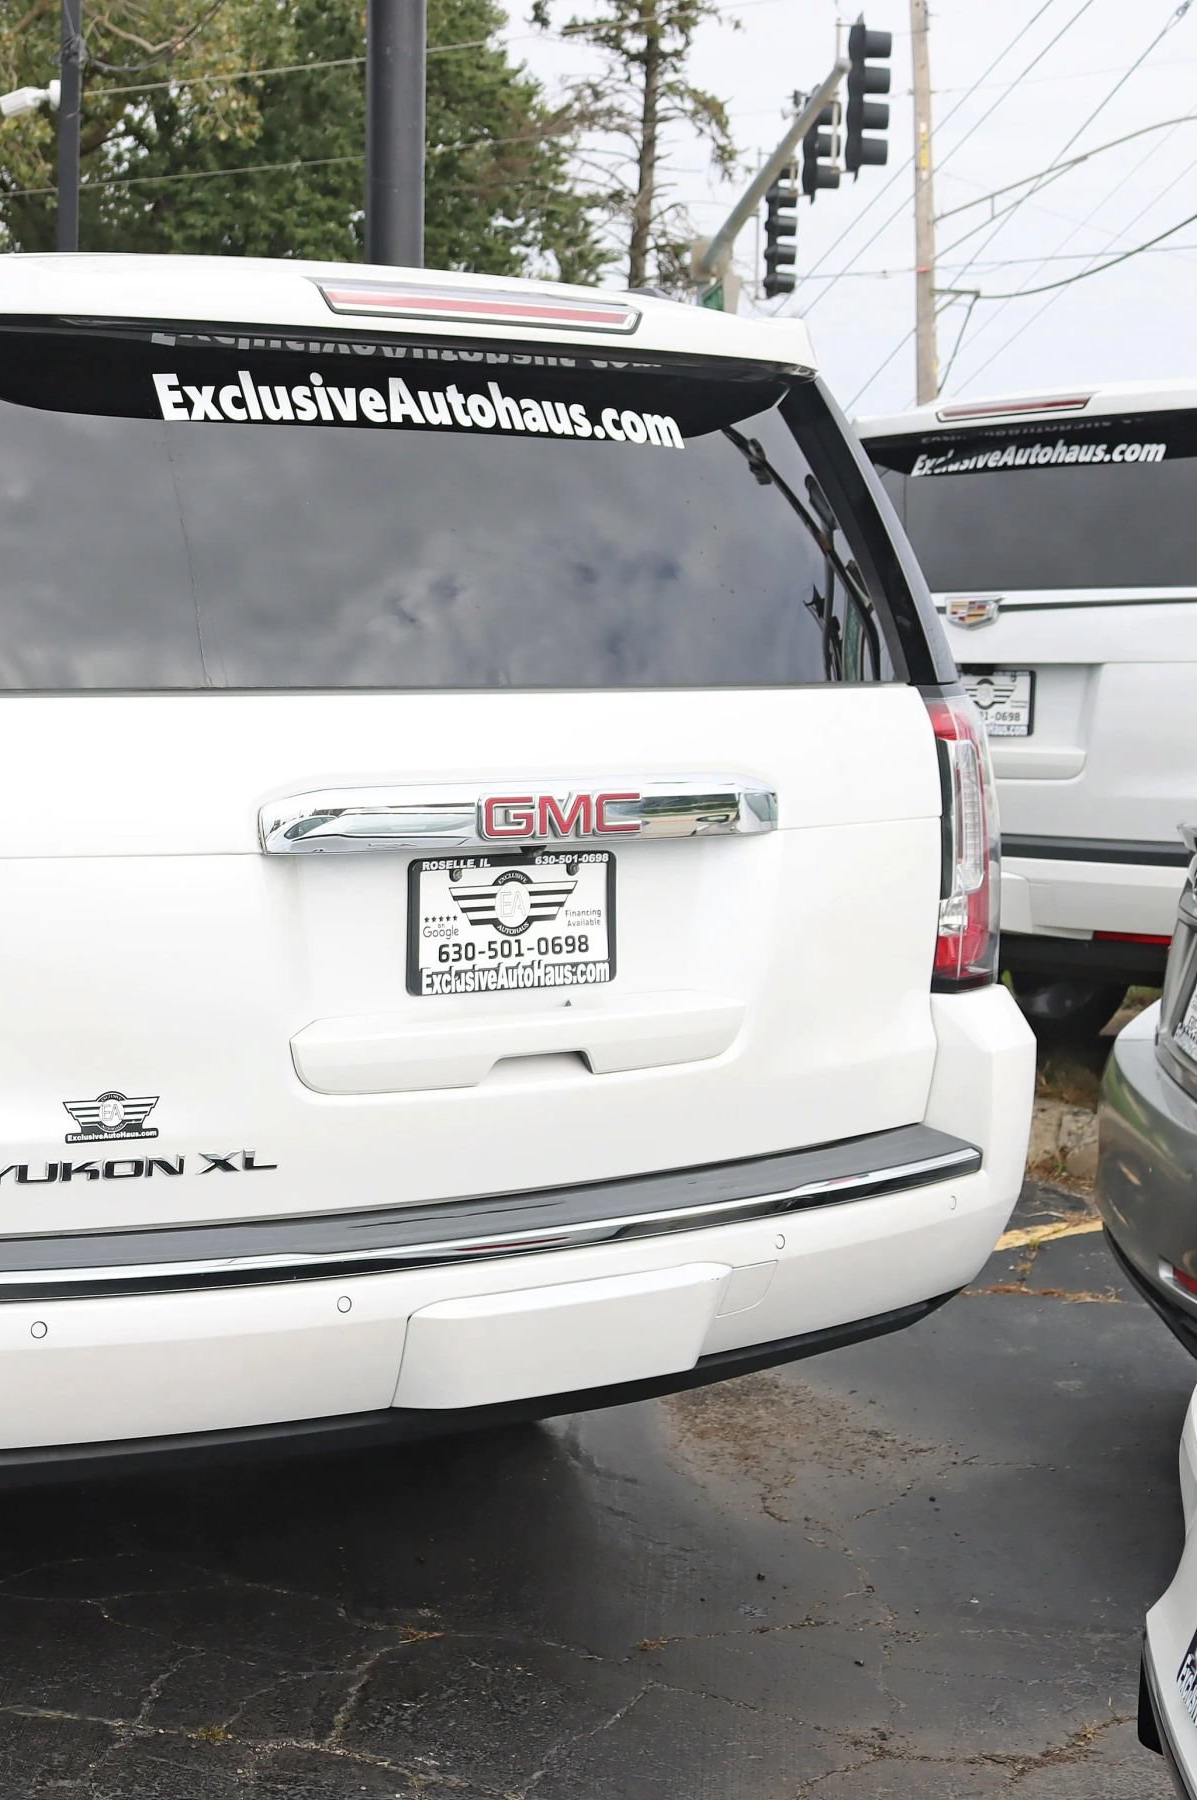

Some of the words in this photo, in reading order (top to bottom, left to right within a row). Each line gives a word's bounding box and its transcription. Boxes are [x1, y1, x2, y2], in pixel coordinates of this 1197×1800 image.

[152, 369, 685, 449] ExclusiveAutohaus.com
[479, 791, 644, 842] GMC
[422, 859, 477, 871] ROSELLE,
[478, 858, 491, 868] IL
[535, 853, 610, 865] 630-501-0698
[498, 872, 527, 884] EXCLUSIVE
[565, 909, 602, 918] Financing
[497, 921, 530, 935] AUTOHAUS
[567, 918, 601, 927] Available
[423, 924, 459, 940] Google
[438, 934, 590, 962] 630-501-0698
[421, 960, 610, 995] ExclusiveAutoHaus.com
[66, 1130, 157, 1142] ExclusiveAutoHaus.com
[195, 1149, 278, 1176] XL
